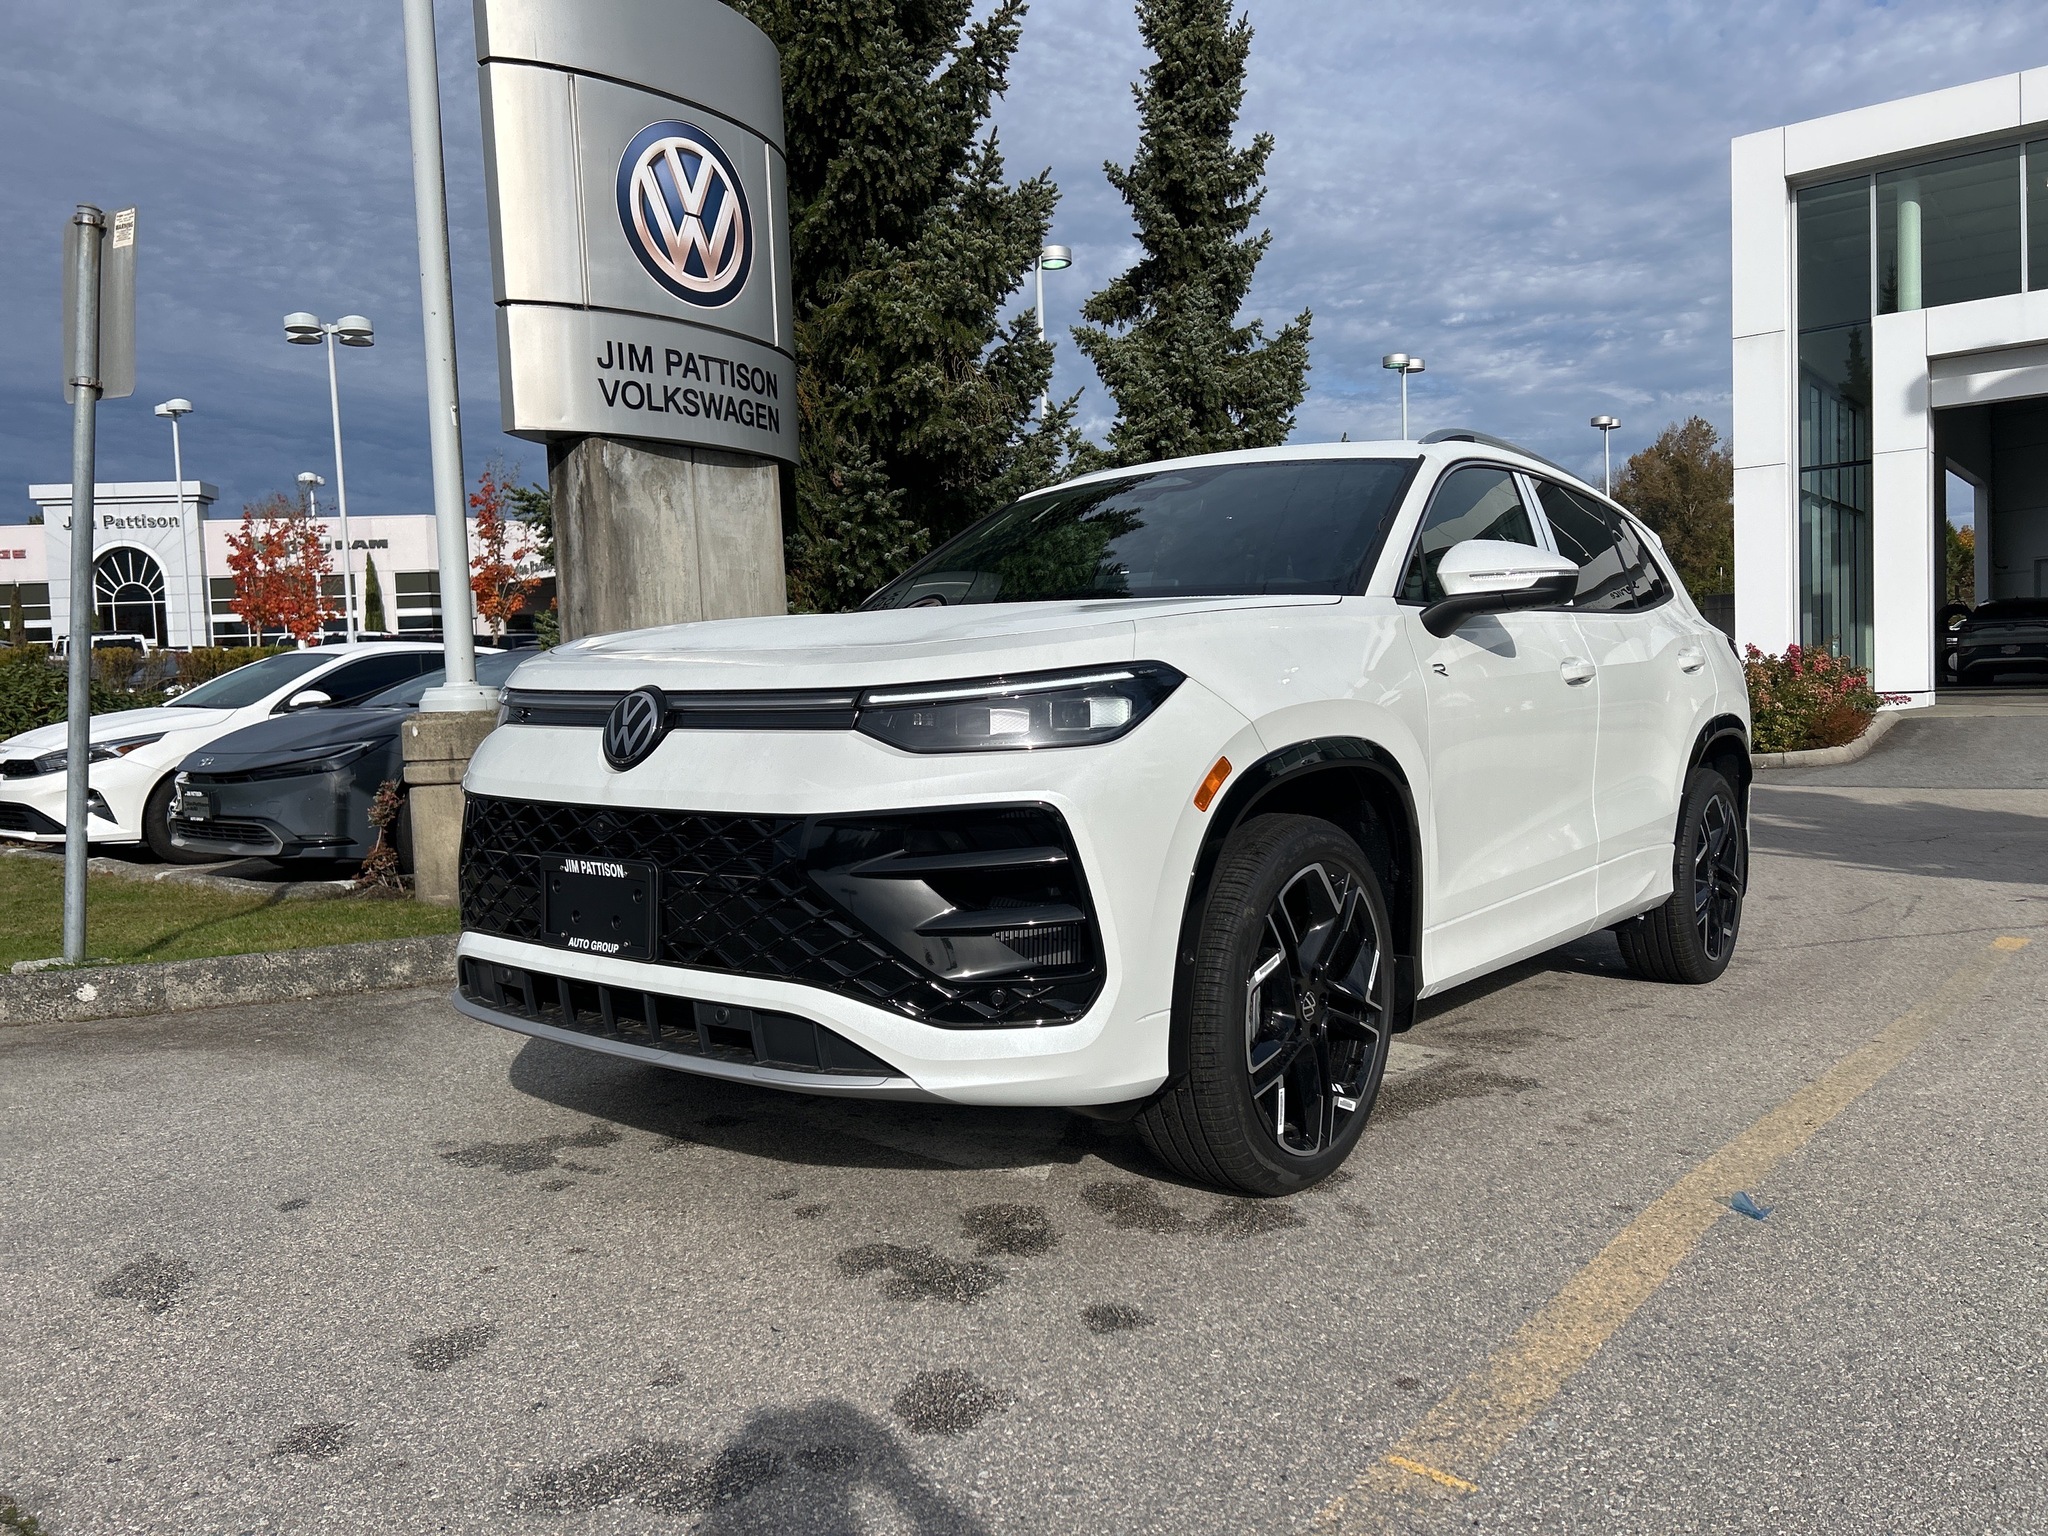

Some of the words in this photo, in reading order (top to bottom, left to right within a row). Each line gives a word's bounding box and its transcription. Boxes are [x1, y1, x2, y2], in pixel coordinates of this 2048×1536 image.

[596, 340, 654, 374] JIM
[664, 348, 779, 400] PATTISON
[597, 378, 780, 434] VOLKSWAGEN
[103, 514, 181, 530] Pattison
[564, 858, 580, 874] JIM
[580, 860, 625, 879] PATTISON
[568, 937, 590, 949] AUTO
[590, 940, 620, 954] GROUP
